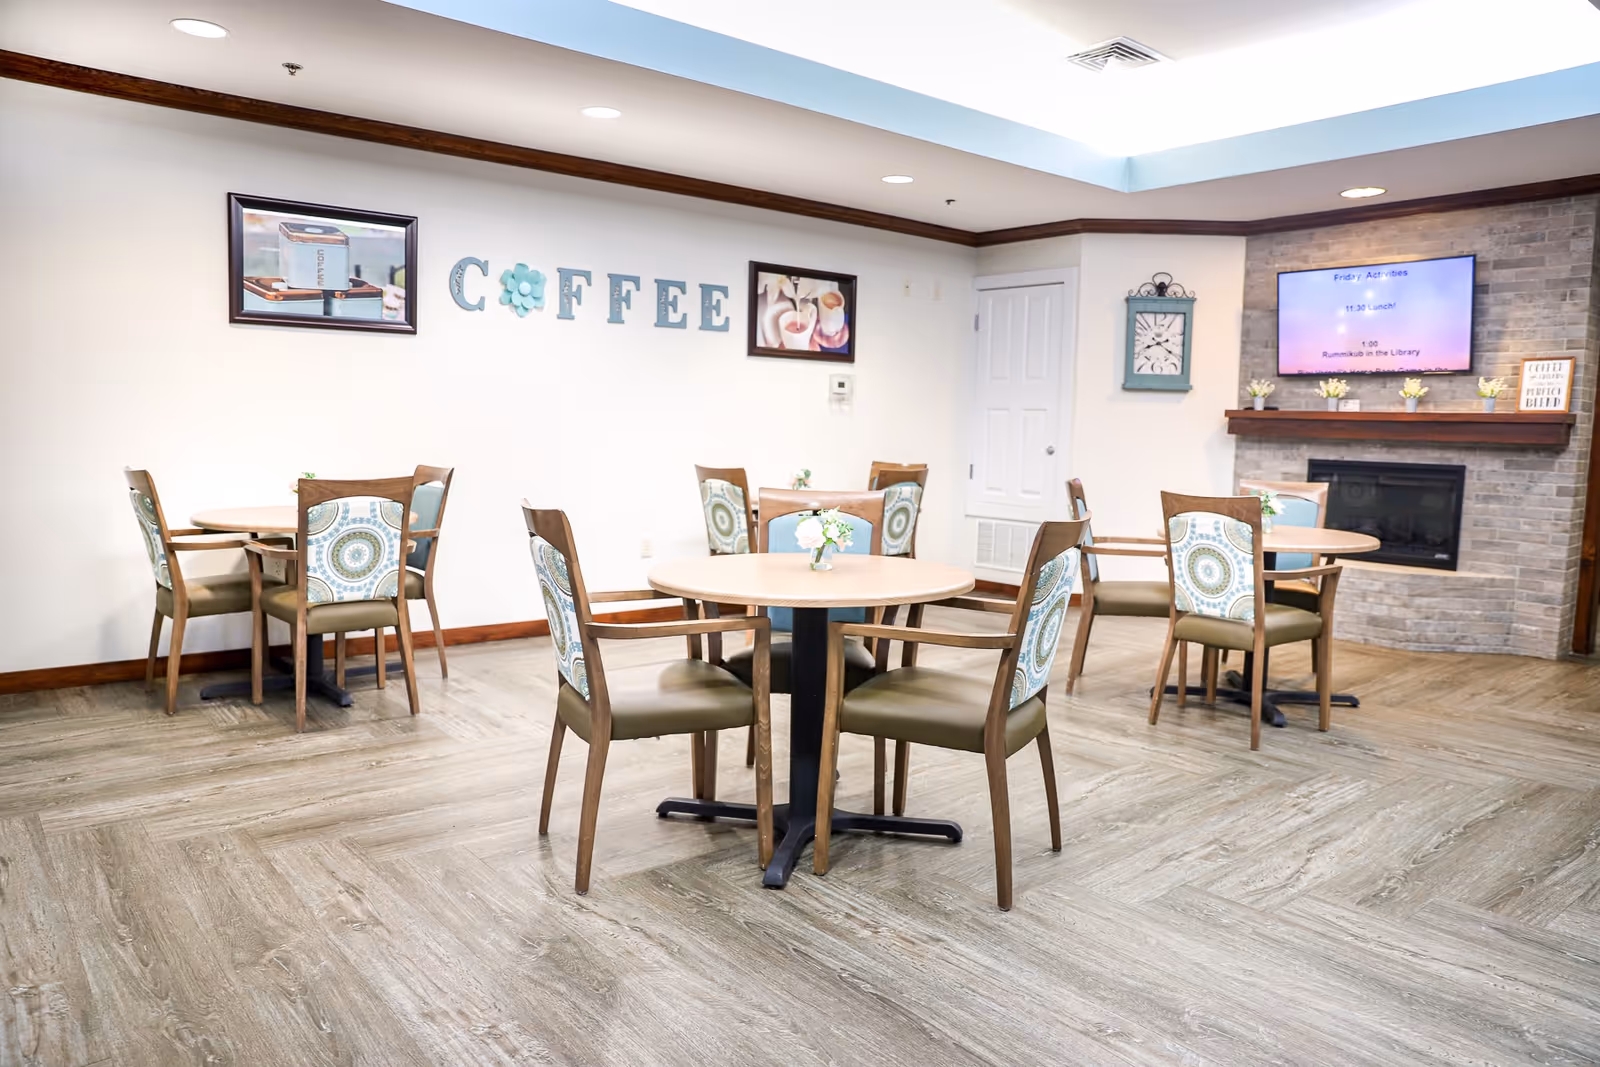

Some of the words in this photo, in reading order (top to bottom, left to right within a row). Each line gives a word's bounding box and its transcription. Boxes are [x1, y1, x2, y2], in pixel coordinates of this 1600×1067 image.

[317, 248, 325, 287] COFFEE
[1333, 272, 1362, 282] Friday
[1366, 269, 1408, 279] Activities
[449, 256, 730, 332] CFFEE
[1345, 304, 1366, 312] 11:30
[1390, 348, 1421, 357] Library
